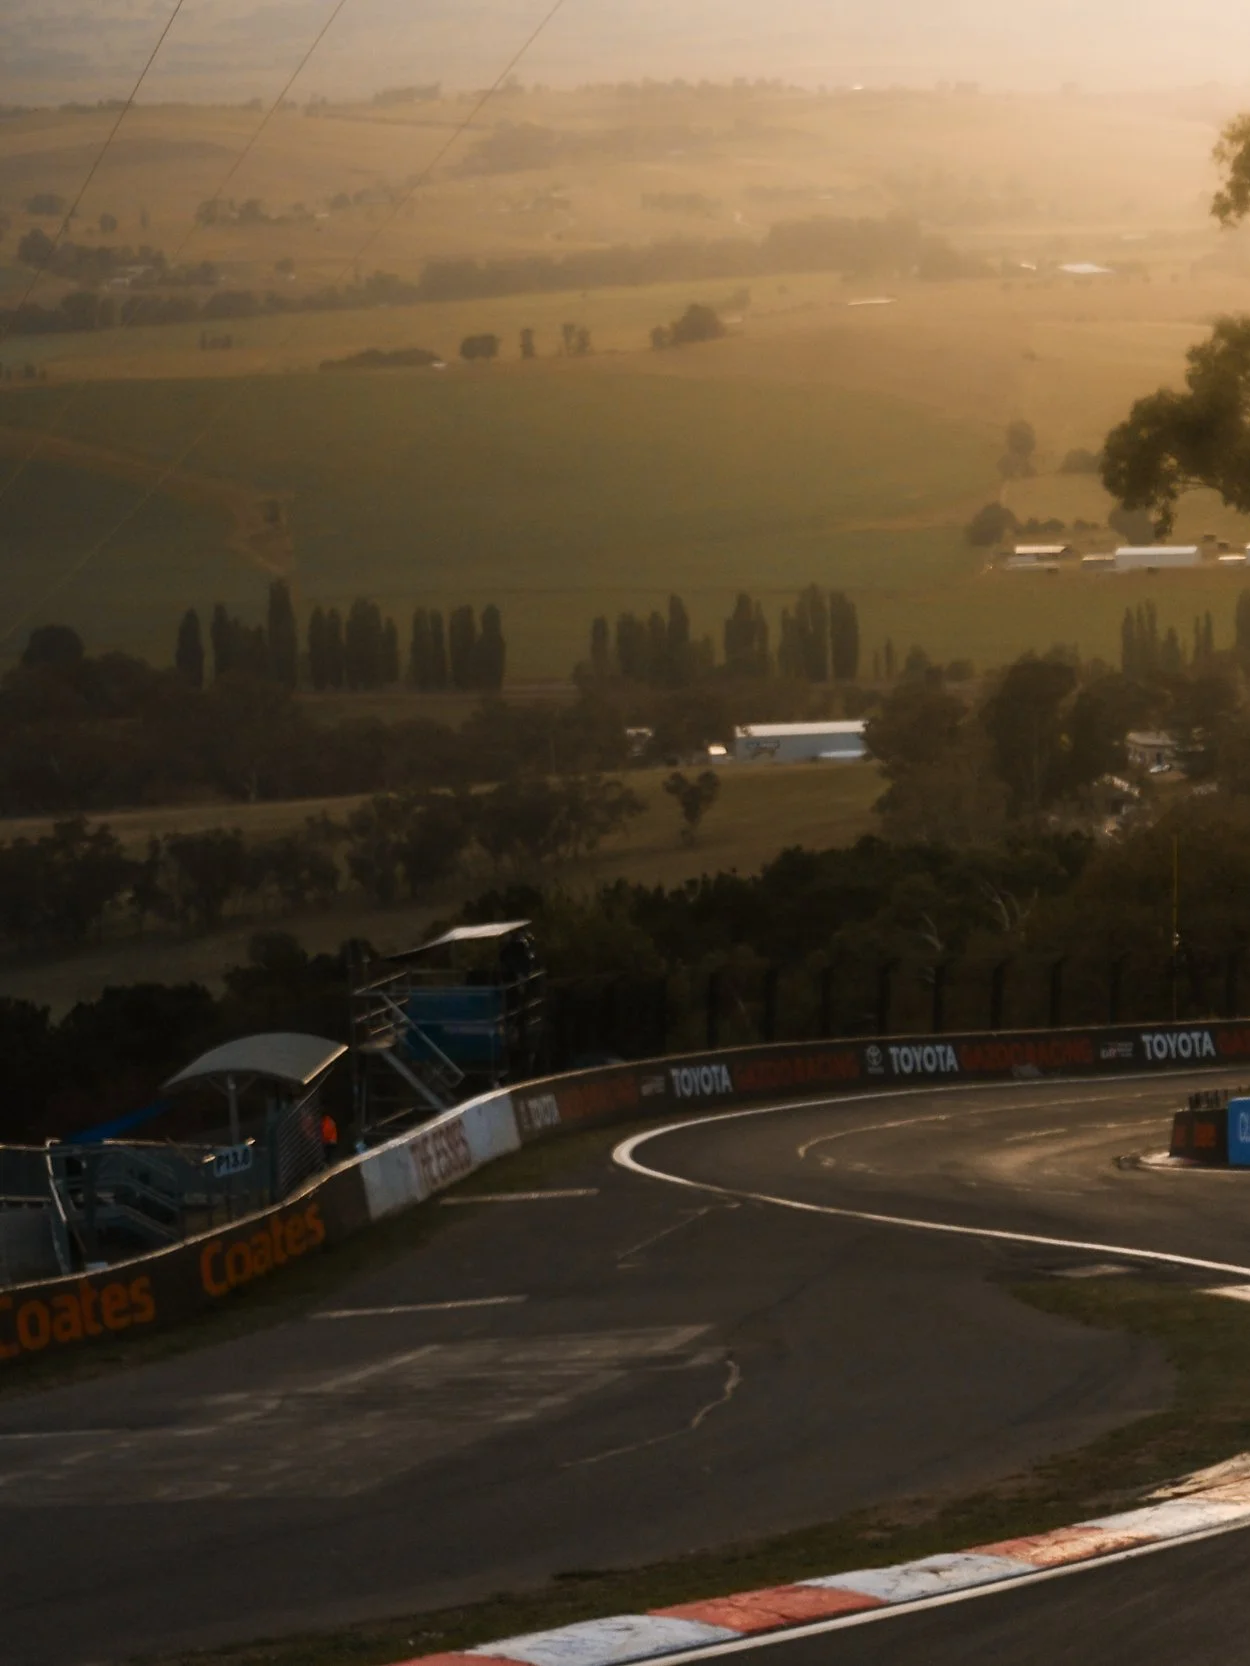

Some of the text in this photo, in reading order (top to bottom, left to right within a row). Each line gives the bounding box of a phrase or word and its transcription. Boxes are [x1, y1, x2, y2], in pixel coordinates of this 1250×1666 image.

[888, 1043, 958, 1075] TOYOTA
[1140, 1030, 1216, 1061] TOYOTA
[669, 1064, 733, 1098] TOYOTA
[200, 1202, 326, 1298] Coates
